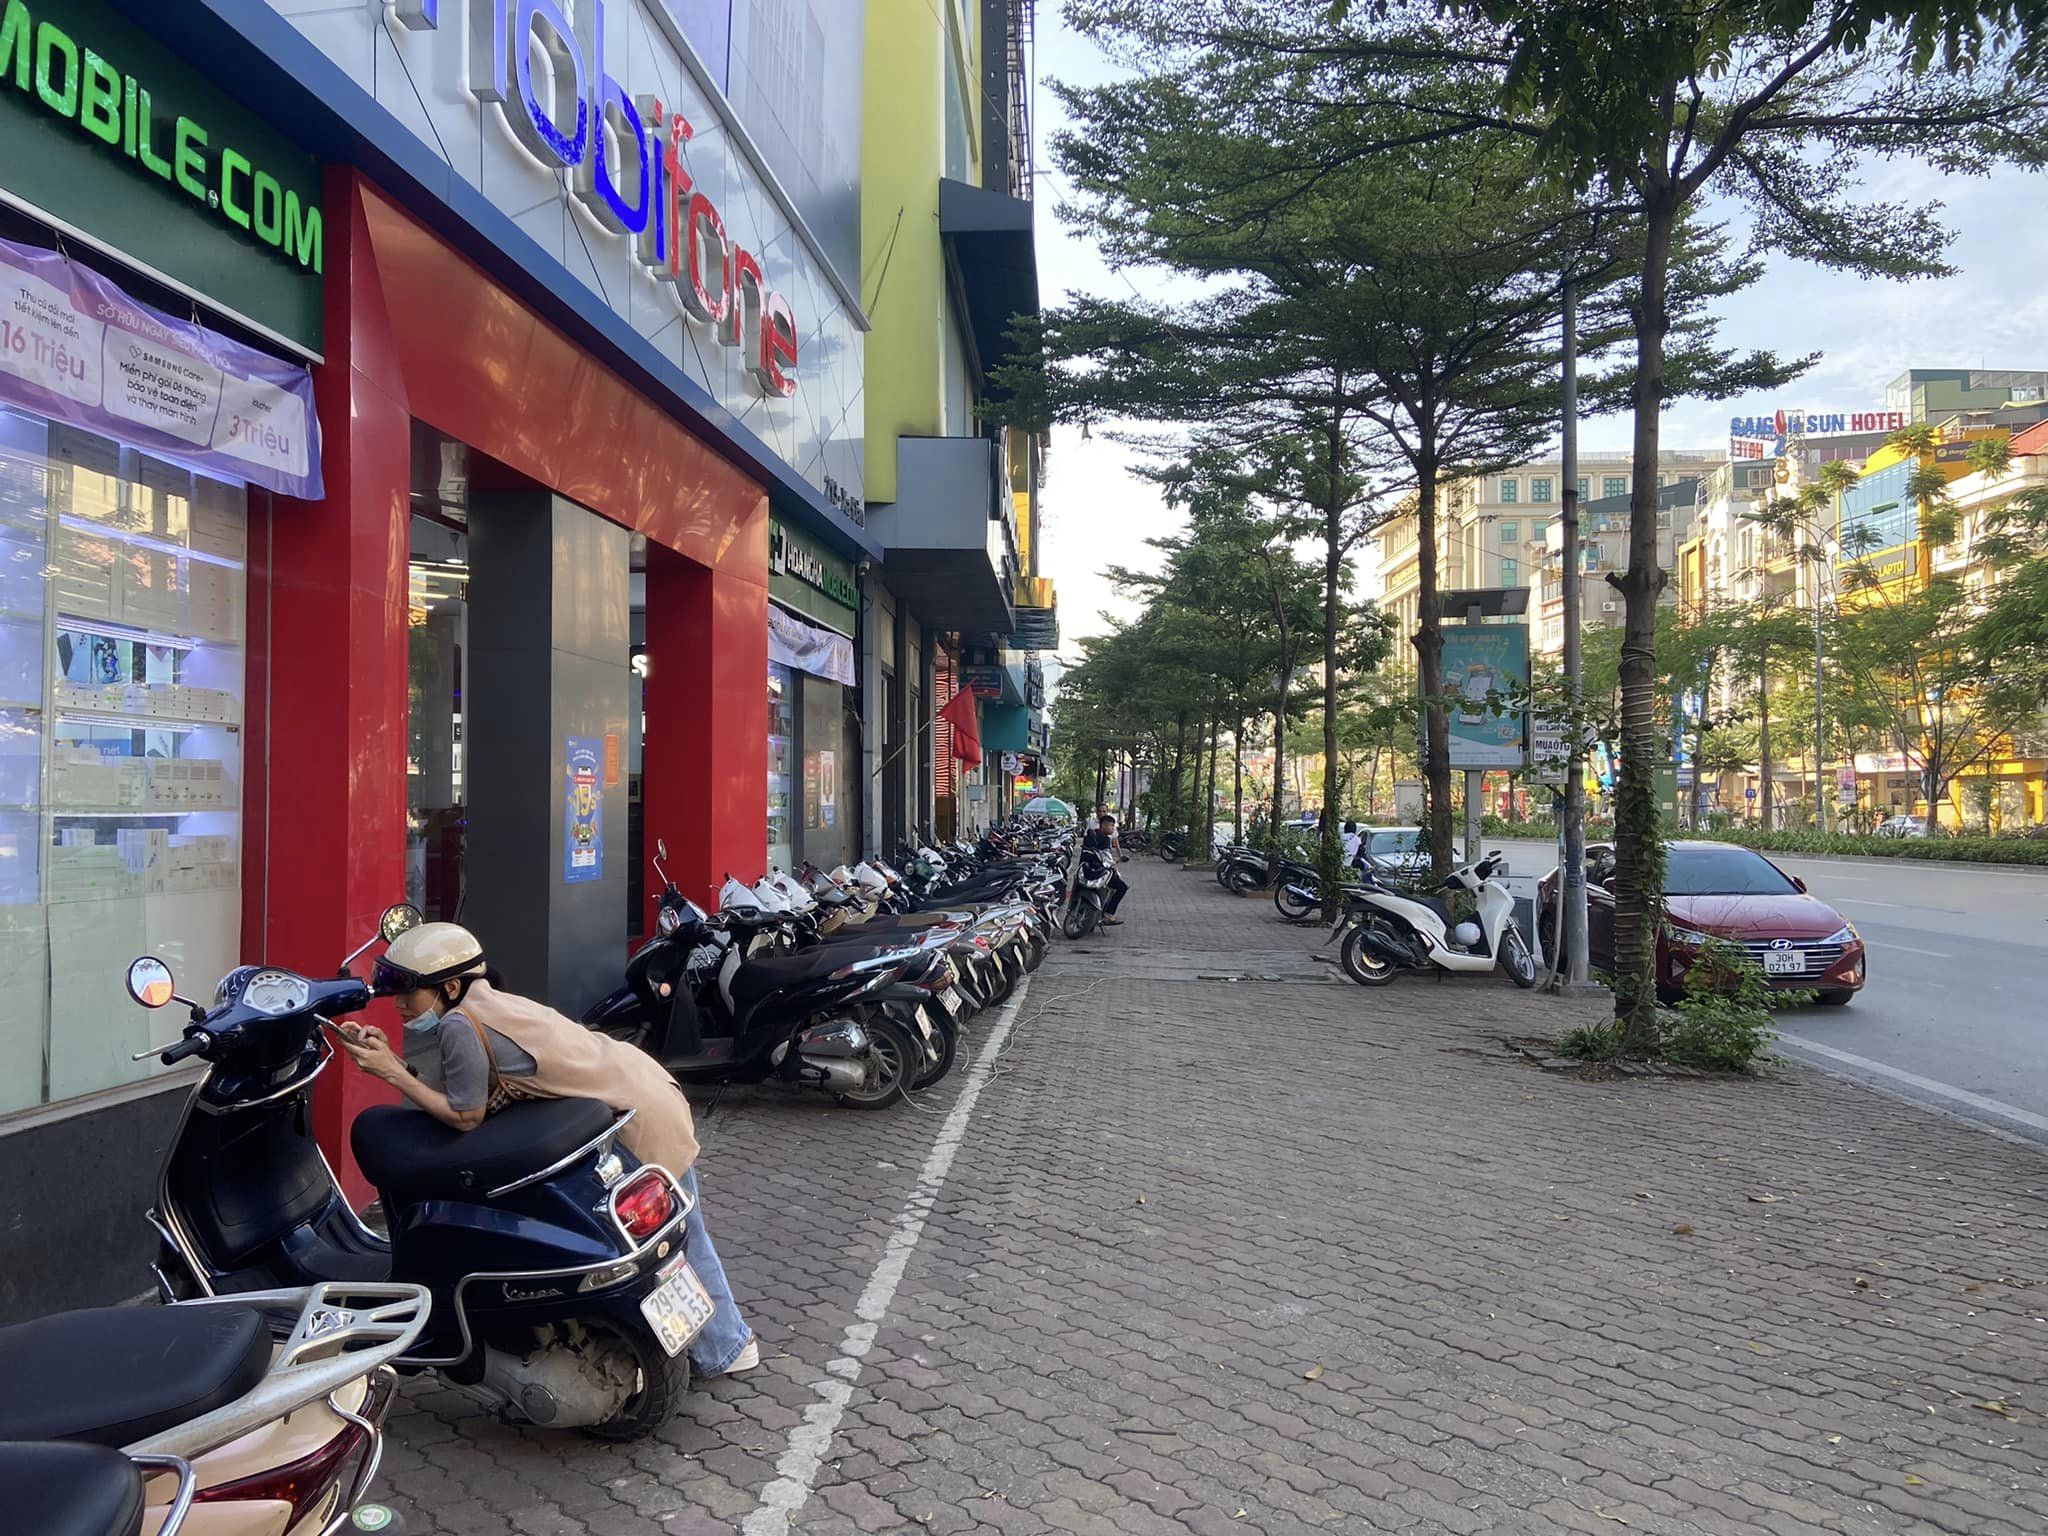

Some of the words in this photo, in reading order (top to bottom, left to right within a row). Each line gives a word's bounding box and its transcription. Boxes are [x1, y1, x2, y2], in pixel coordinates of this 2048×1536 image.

[396, 0, 799, 399] obifone
[20, 288, 37, 304] Thu
[141, 322, 169, 342] NGAY
[2, 319, 26, 353] 16
[30, 332, 85, 382] Triệu
[142, 352, 183, 375] SAMSUNG
[142, 369, 157, 383] phí
[157, 375, 173, 389] gói
[173, 381, 183, 393] 06
[184, 384, 207, 403] tháng
[147, 385, 159, 401] vệ
[138, 397, 158, 414] thay
[1731, 412, 1804, 434] SAIGN
[1806, 413, 1845, 433] SUN
[1851, 412, 1904, 431] HOTEL
[229, 415, 240, 437] 3
[242, 418, 290, 457] Triệu
[1775, 953, 1794, 962] 30H
